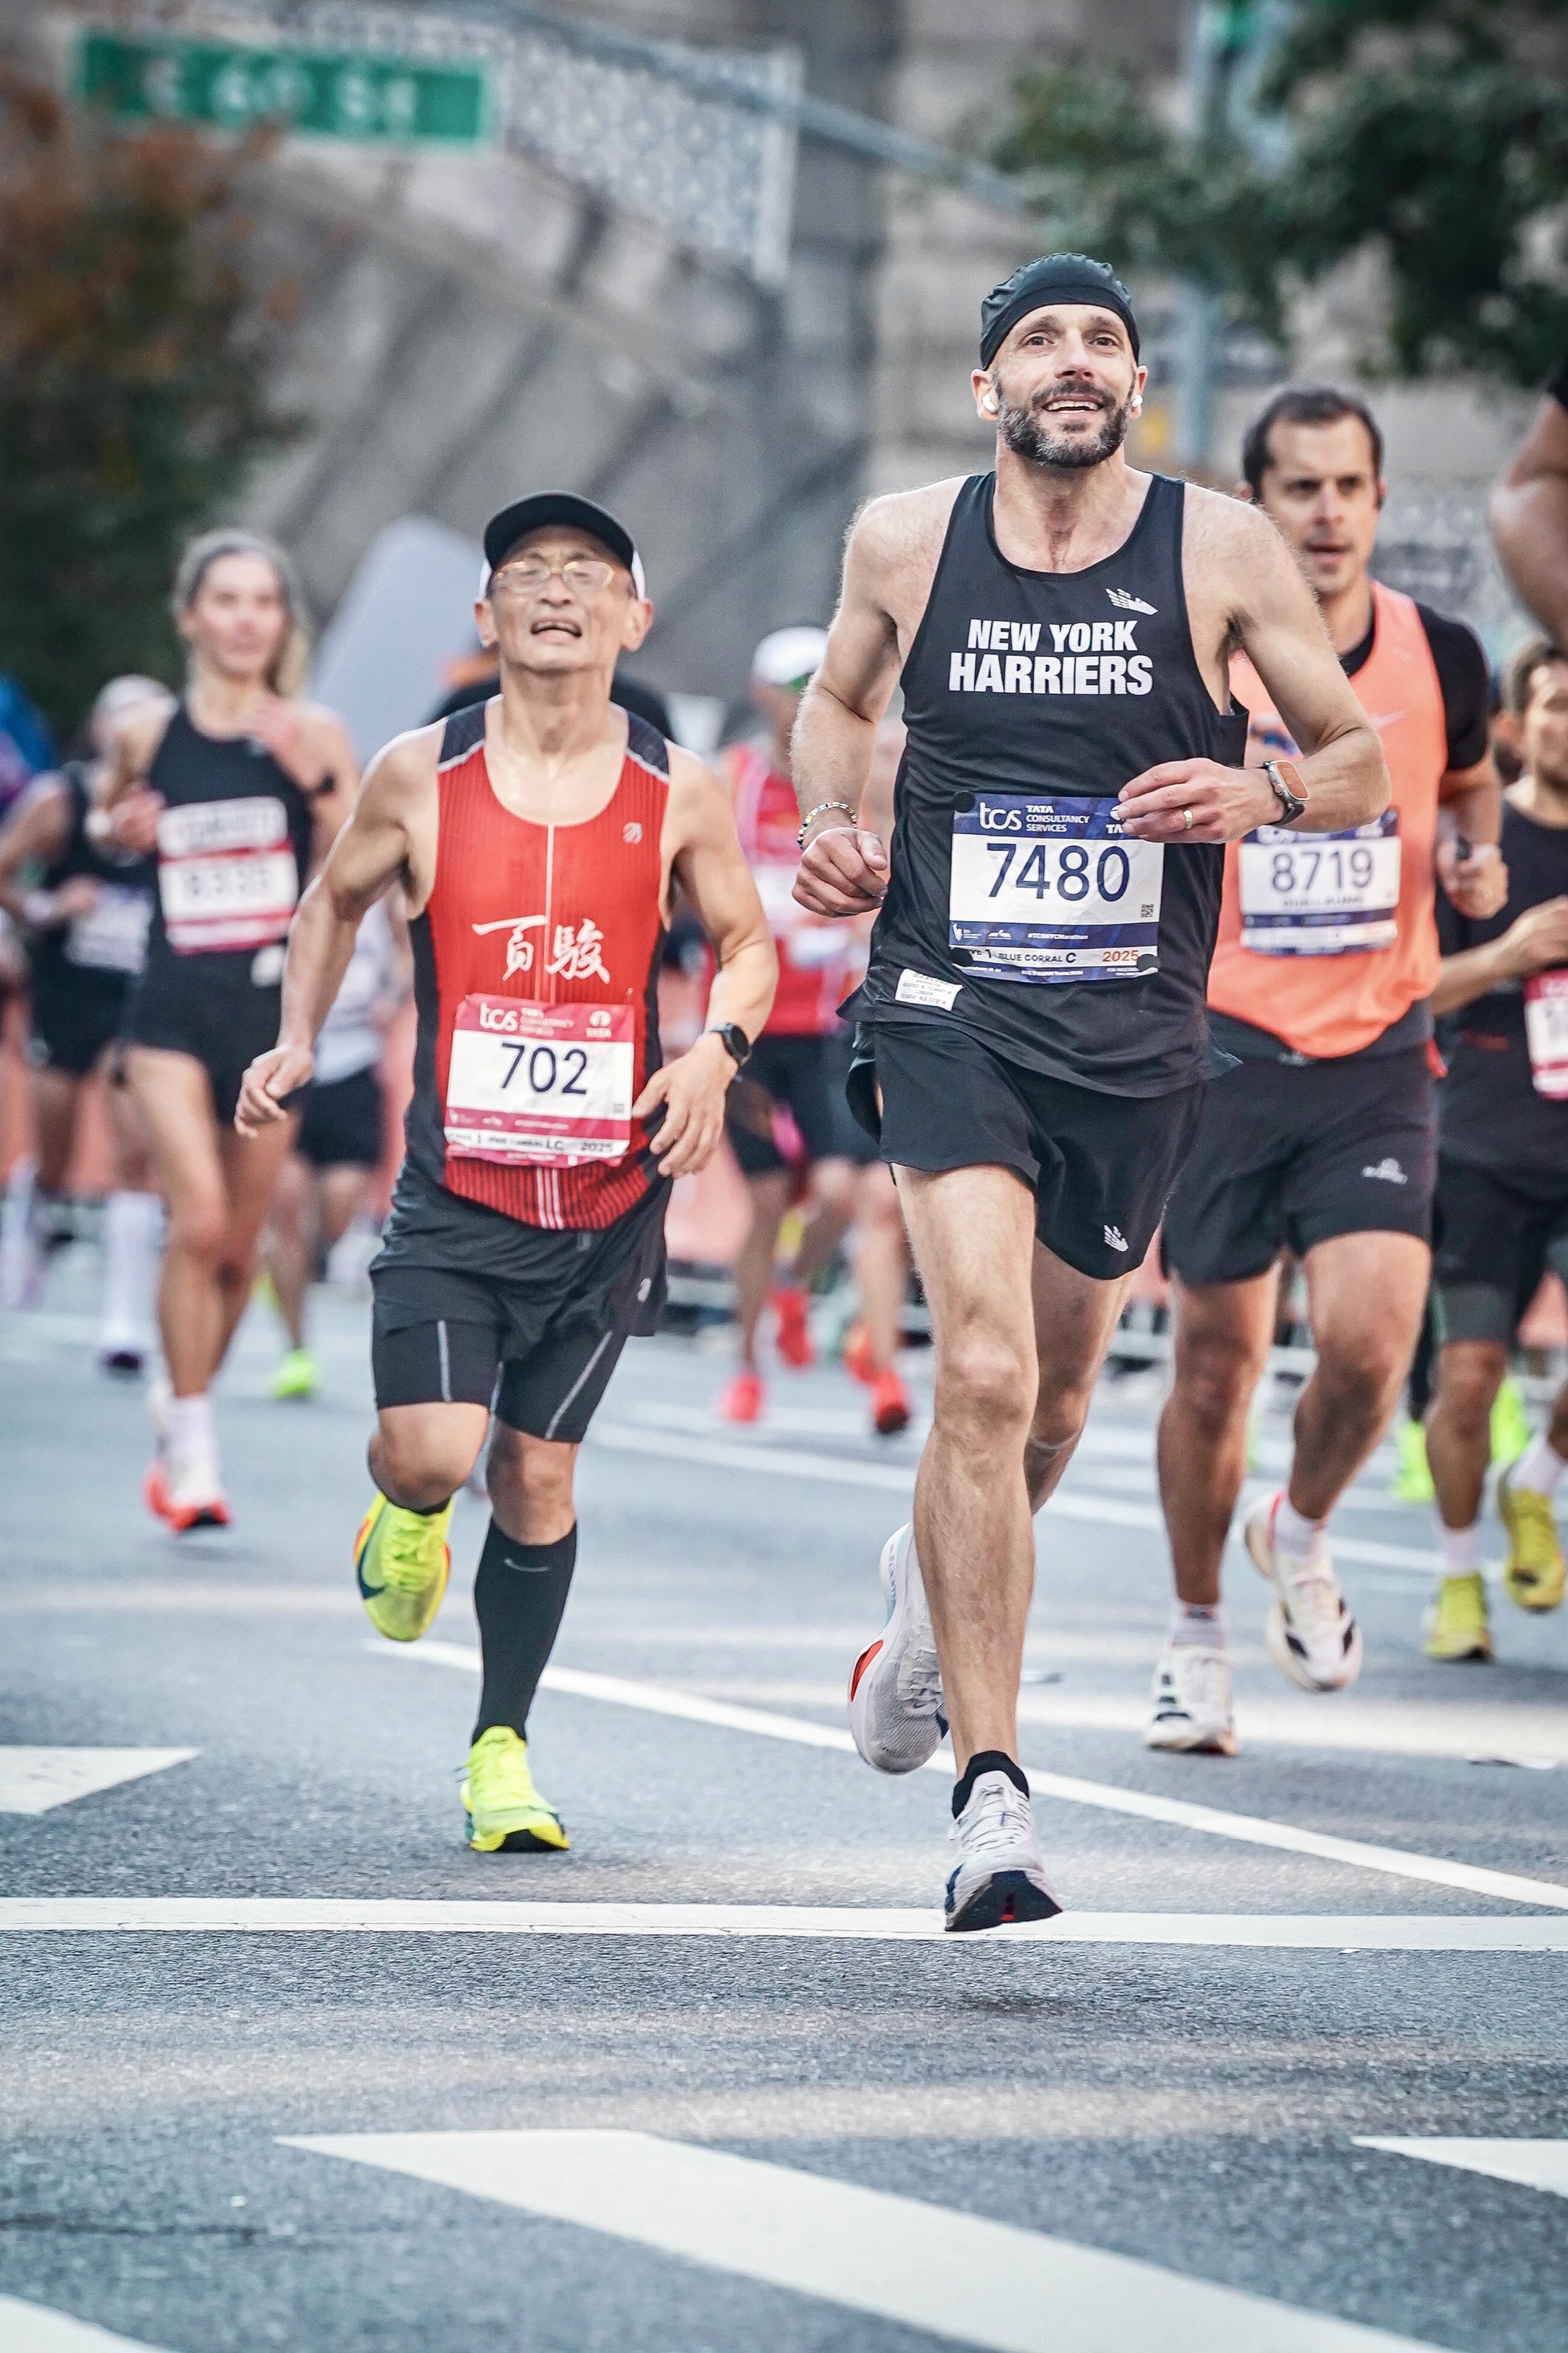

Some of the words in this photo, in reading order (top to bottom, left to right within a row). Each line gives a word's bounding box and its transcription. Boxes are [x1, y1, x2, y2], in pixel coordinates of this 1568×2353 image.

[968, 619, 1040, 652] NEW
[1050, 620, 1139, 653] YORK
[949, 652, 1153, 695] HARRIERS
[979, 802, 1022, 831] tcs
[1026, 805, 1054, 814] TATA
[1026, 815, 1090, 824] CONSULTANCY
[1026, 824, 1067, 833] SERVICES
[1106, 824, 1124, 834] TA
[986, 842, 1130, 902] 7480
[1271, 848, 1372, 892] 8719
[998, 953, 1023, 961] BLUE
[1025, 954, 1063, 962] CORRAL
[1066, 952, 1077, 964] C
[1102, 950, 1139, 962] 2025
[479, 1002, 518, 1032] tcs
[501, 1042, 588, 1096] 702
